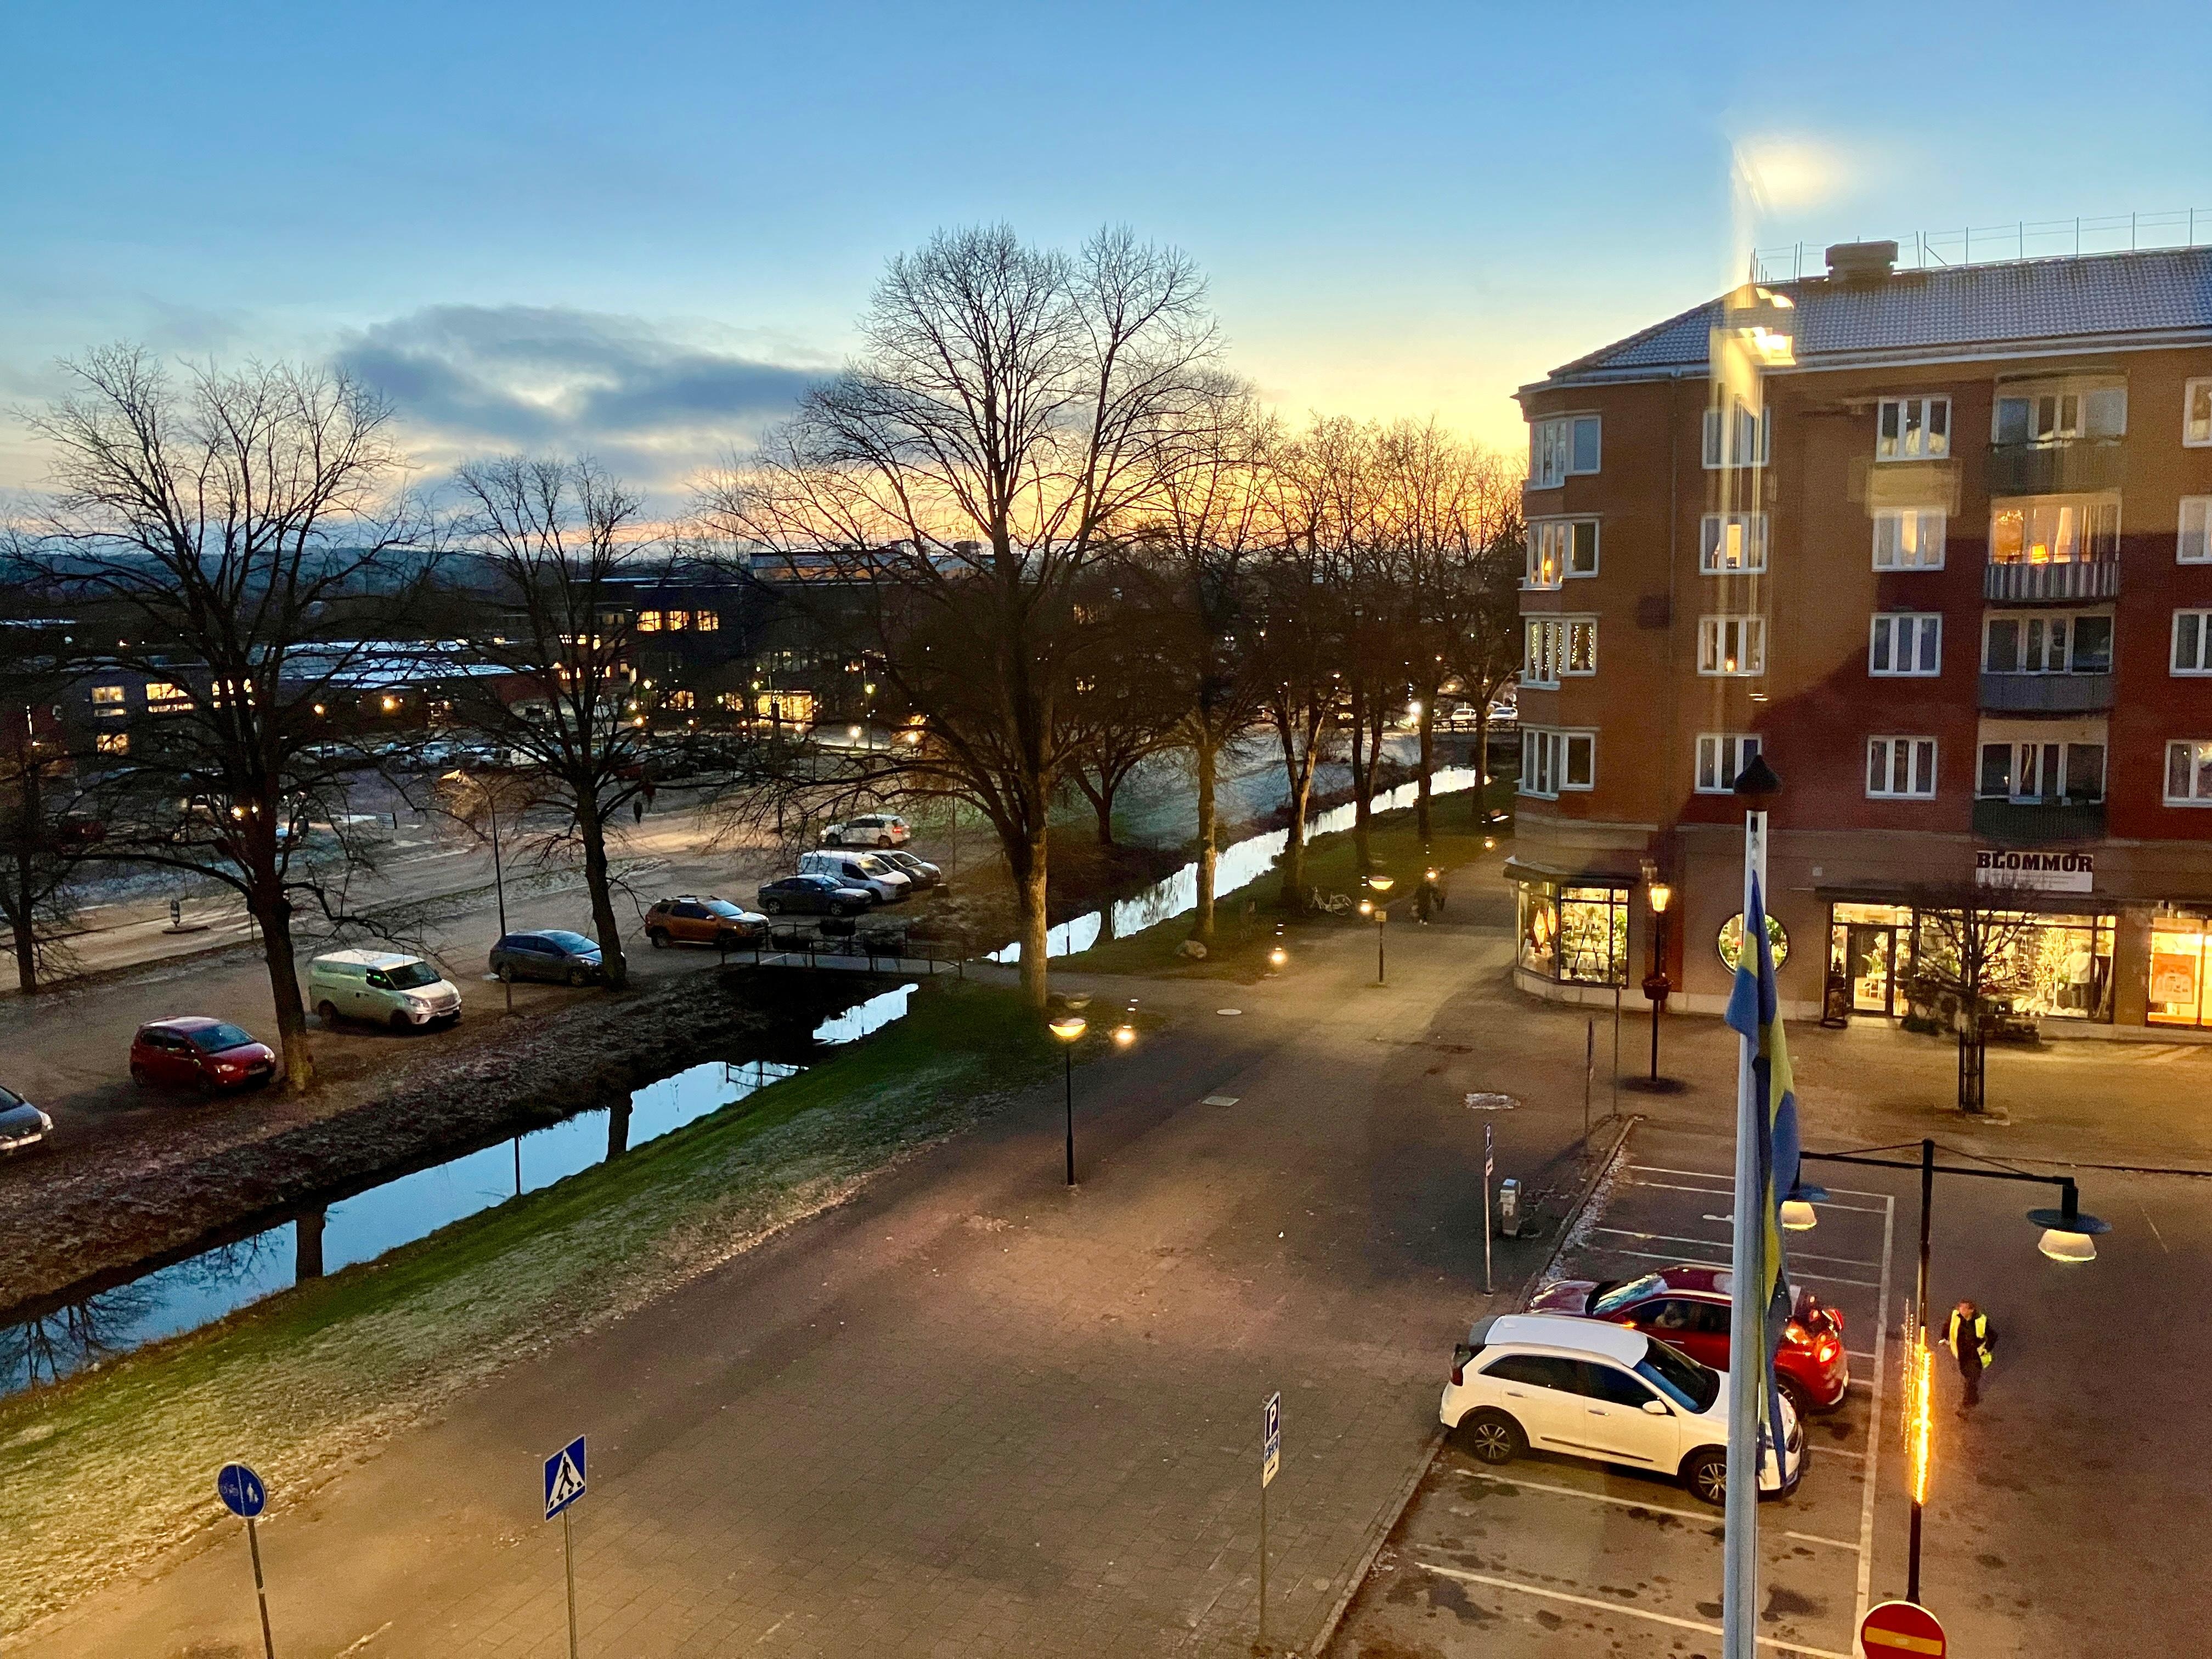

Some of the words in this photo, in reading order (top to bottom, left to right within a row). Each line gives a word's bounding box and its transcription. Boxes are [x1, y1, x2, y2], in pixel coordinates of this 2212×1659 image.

[1976, 852, 2093, 872] BLOMMOR
[1486, 1125, 1491, 1147] P
[1269, 1403, 1277, 1437] P
